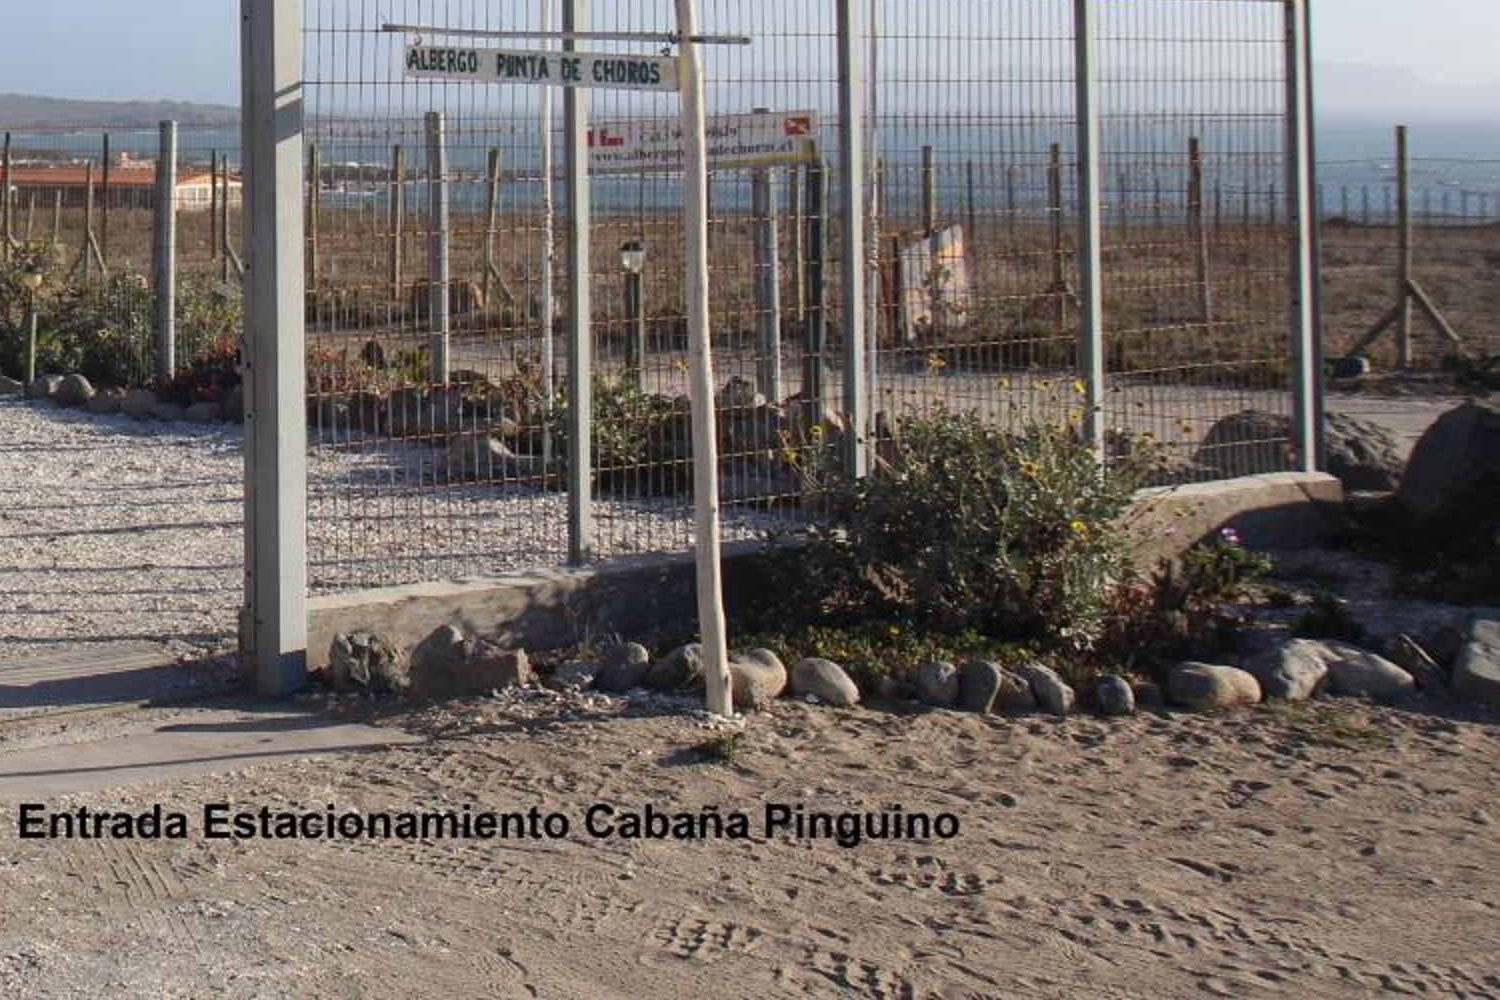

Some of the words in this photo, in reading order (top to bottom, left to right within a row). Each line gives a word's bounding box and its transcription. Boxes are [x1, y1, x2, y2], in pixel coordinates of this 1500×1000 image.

[407, 49, 478, 73] ALBERGO
[496, 53, 549, 79] PUNTA
[561, 57, 581, 81] DE
[593, 59, 661, 85] CHOROS
